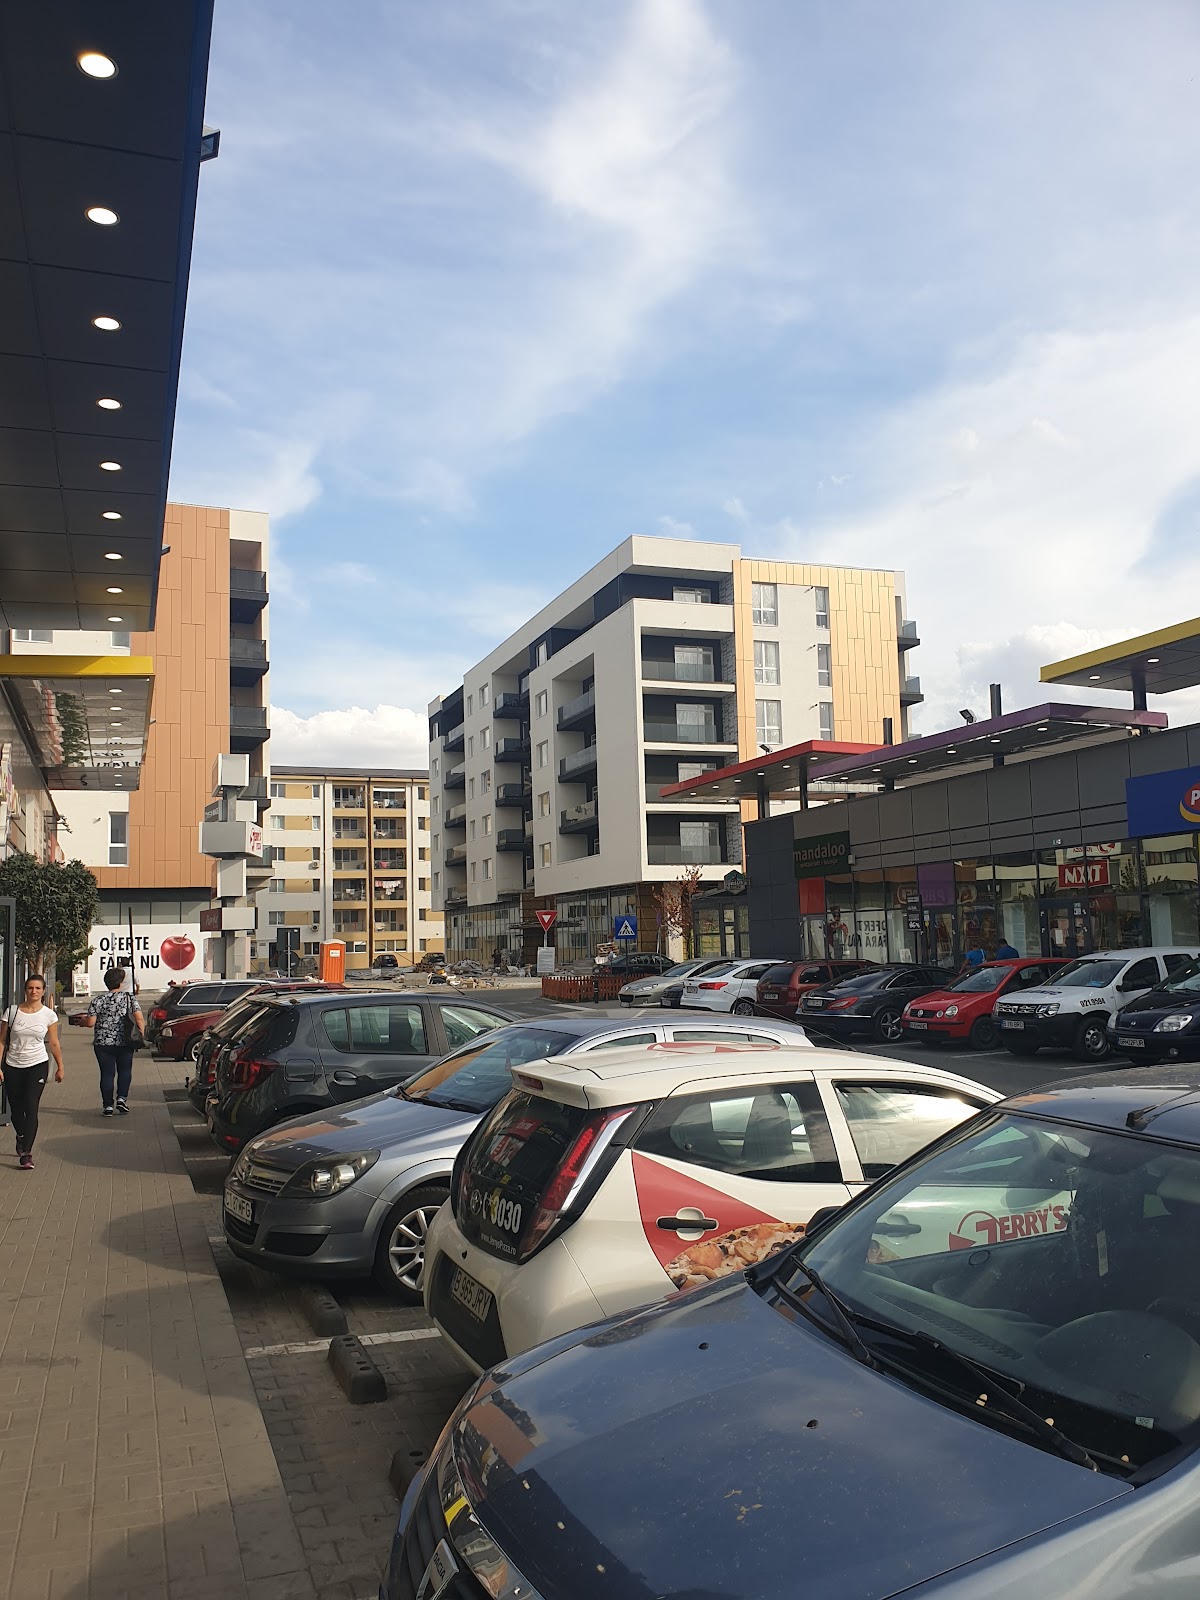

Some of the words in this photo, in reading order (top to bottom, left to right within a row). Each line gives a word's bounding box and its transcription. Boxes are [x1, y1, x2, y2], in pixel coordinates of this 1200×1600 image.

[793, 842, 845, 861] mandaloo
[140, 954, 160, 969] NU
[453, 1270, 462, 1292] B
